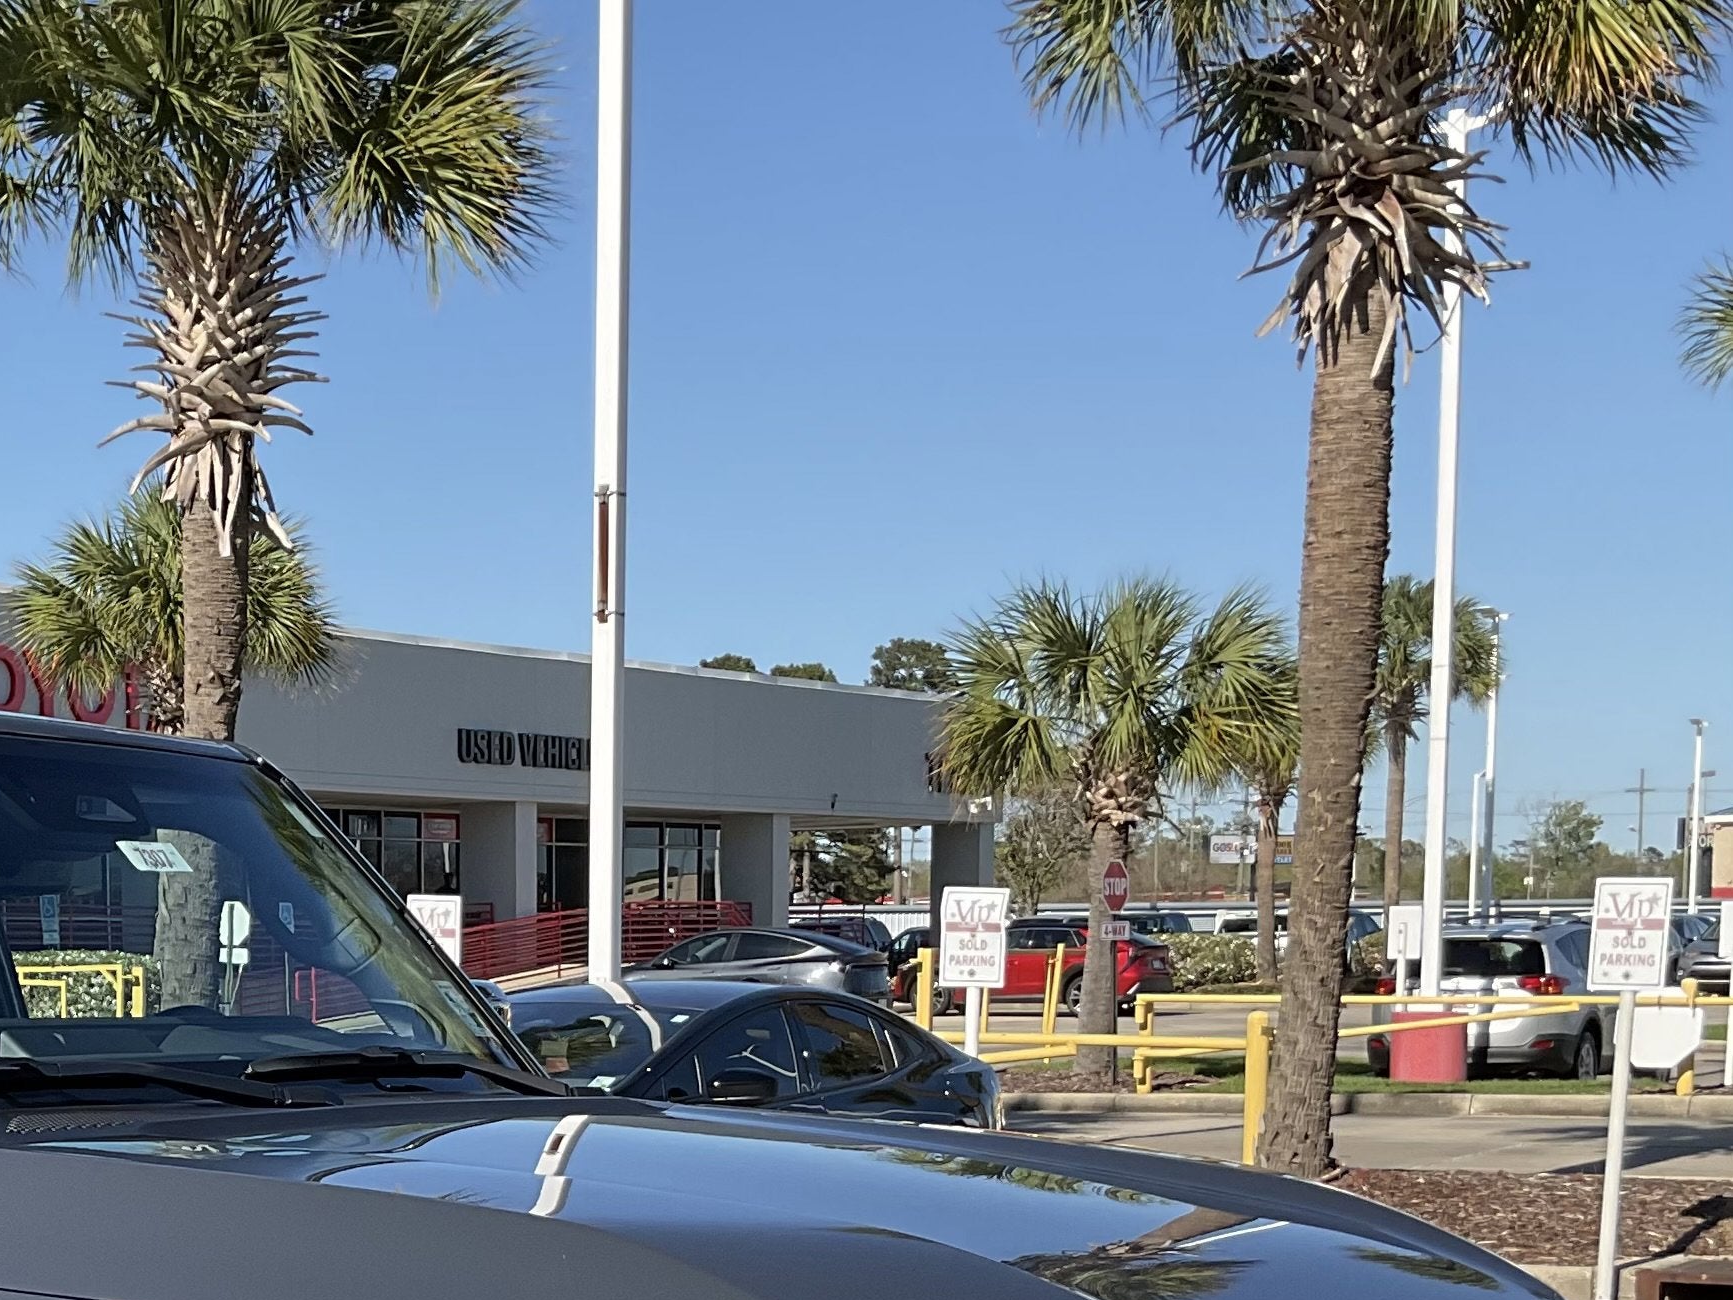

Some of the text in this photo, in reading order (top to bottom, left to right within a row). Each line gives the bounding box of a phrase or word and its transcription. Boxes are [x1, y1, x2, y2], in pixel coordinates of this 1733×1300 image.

[457, 728, 591, 771] USED VEHICL
[1104, 877, 1127, 896] STOP
[1104, 925, 1127, 937] 4-WAY
[958, 939, 988, 951] SOLD
[1611, 936, 1647, 949] SOLD
[949, 954, 996, 967] PARKING
[1599, 953, 1656, 967] PARKING
